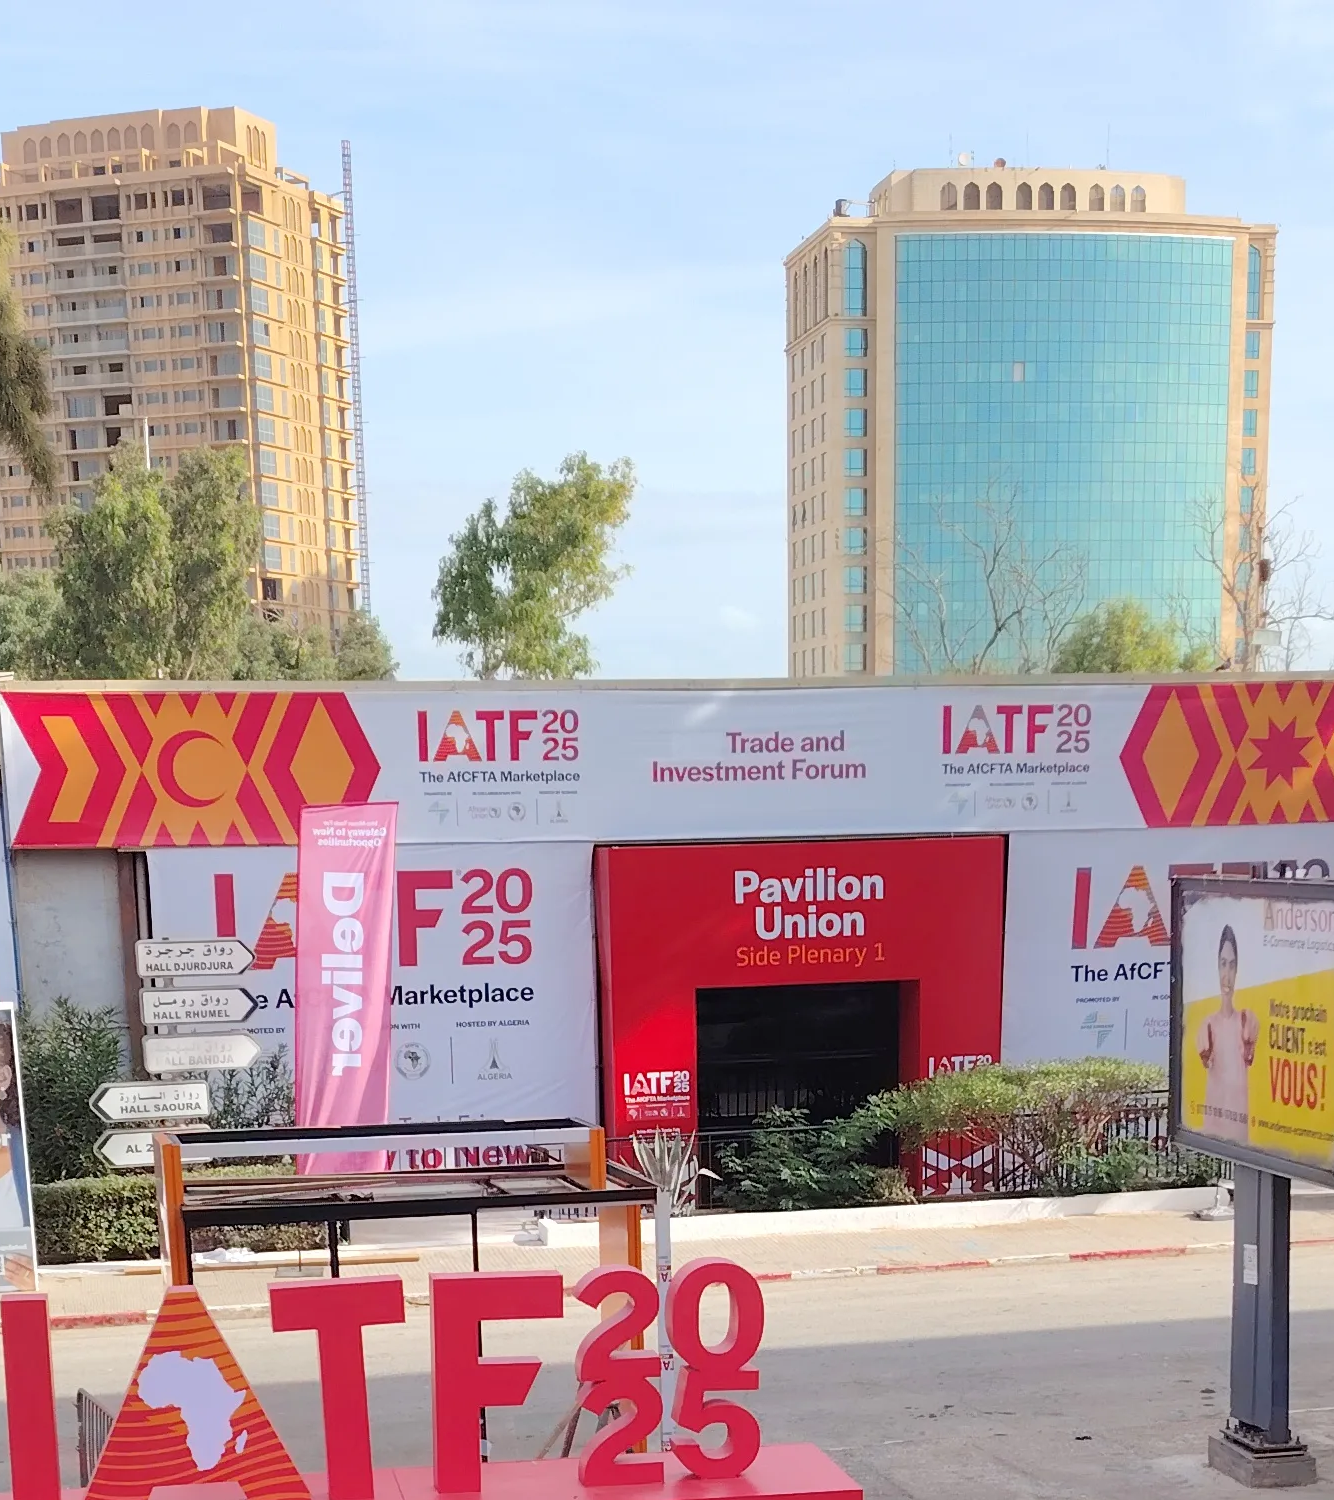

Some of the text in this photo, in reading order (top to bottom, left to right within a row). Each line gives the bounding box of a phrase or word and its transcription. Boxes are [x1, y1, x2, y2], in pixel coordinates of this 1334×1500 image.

[541, 709, 579, 734] 20
[1056, 703, 1092, 727] 20
[417, 710, 538, 762] IATF
[726, 730, 845, 753] Trade and
[942, 704, 1054, 755] IATF
[1056, 730, 1091, 753] 25
[542, 737, 579, 762] 25
[419, 770, 580, 784] The AfCFTA Marketplace
[652, 758, 866, 783] Investment Forum
[942, 762, 1090, 776] The AfCFTA Marketplace
[460, 868, 533, 915] 20
[734, 867, 884, 904] Pavilion
[755, 904, 865, 940] Union
[462, 919, 533, 966] 25
[736, 942, 885, 967] Side Plenary 1
[146, 961, 233, 972] HALL DJURDJURA
[1071, 962, 1171, 982] The AfCF
[153, 1010, 230, 1020] HALL RHUMEL
[455, 1020, 486, 1028] HOSTED
[498, 1018, 530, 1027] ALGERIA
[1269, 1023, 1306, 1055] CLIENT
[188, 1054, 234, 1066] BAHDJA
[477, 1072, 513, 1081] ALGERIA
[623, 1071, 673, 1096] IATF
[673, 1070, 689, 1082] 20
[673, 1082, 689, 1093] 25
[120, 1102, 202, 1115] HALL SAOURA
[125, 1144, 145, 1154] AL
[573, 1256, 765, 1381] 20
[578, 1366, 761, 1487] 25
